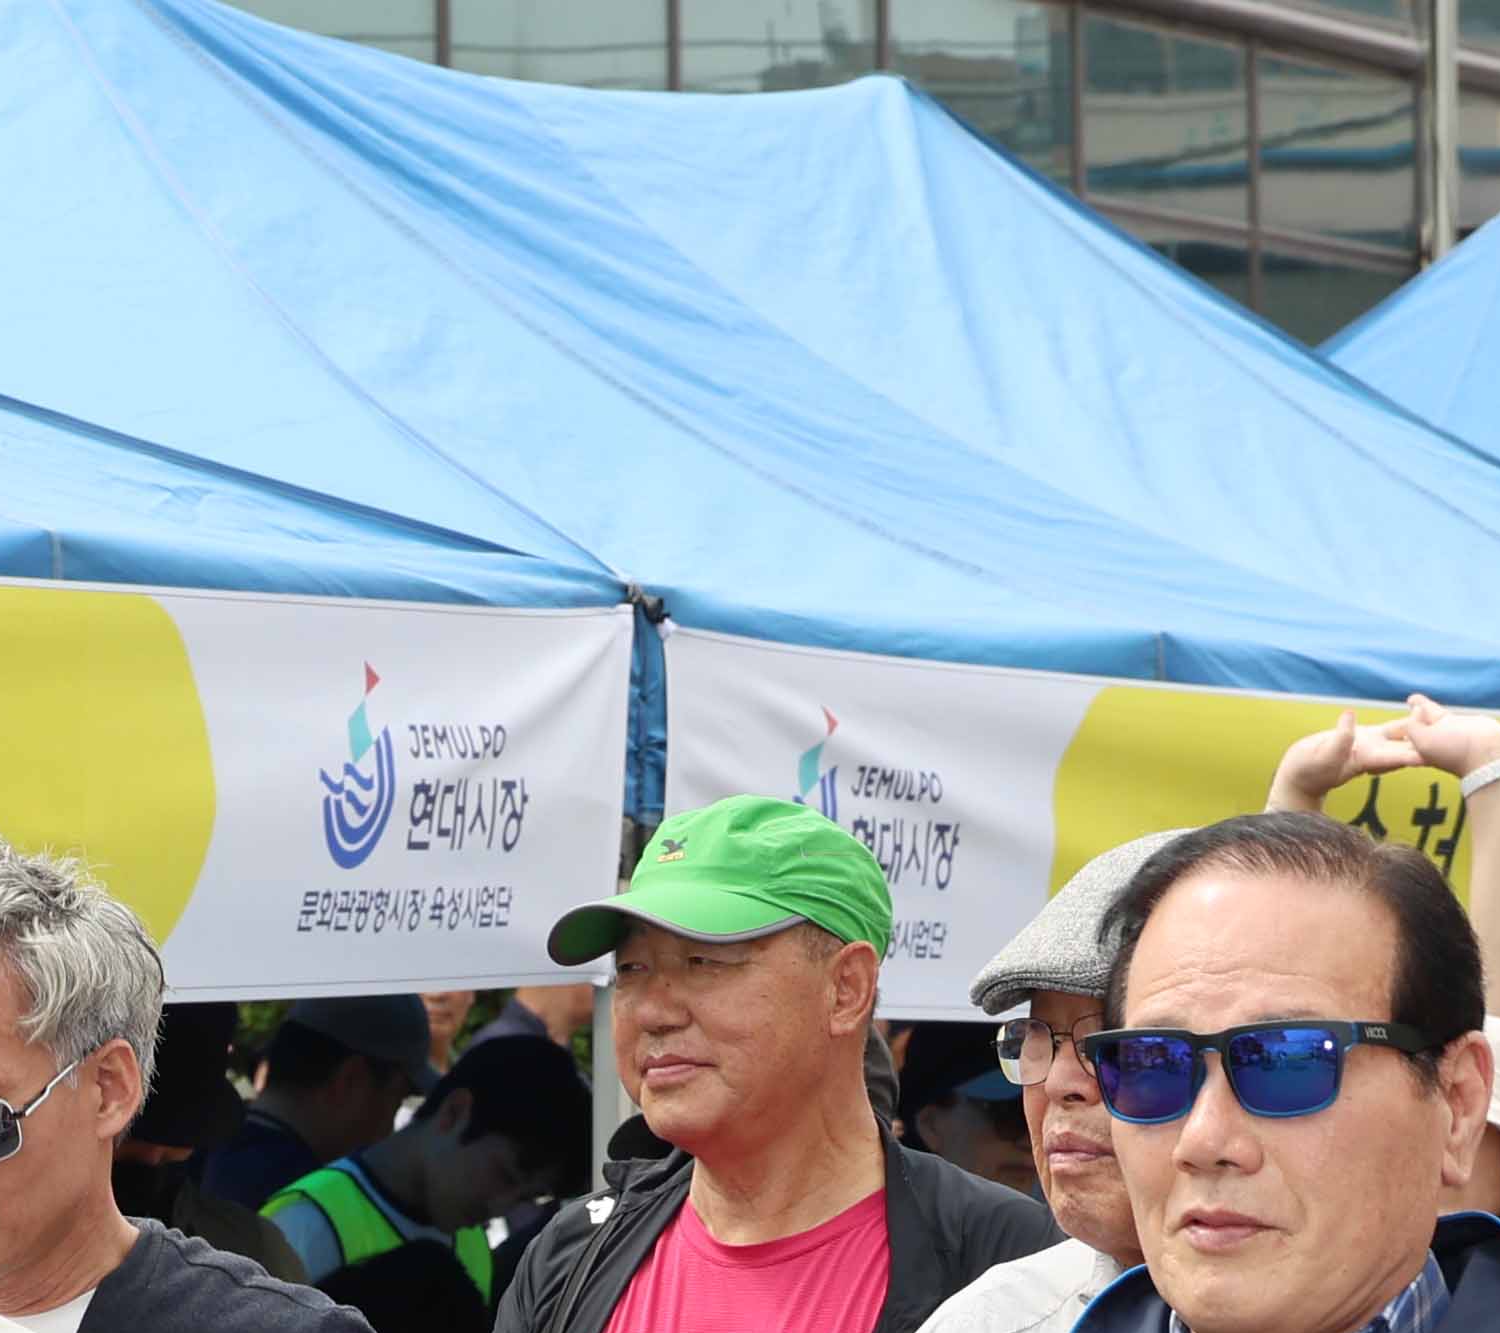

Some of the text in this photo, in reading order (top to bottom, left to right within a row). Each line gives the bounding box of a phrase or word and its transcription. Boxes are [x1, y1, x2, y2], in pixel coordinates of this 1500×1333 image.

[408, 724, 507, 759] JEMULPO
[850, 764, 943, 804] JEMULPO
[406, 777, 529, 853] 현대시장
[297, 885, 513, 933] 문화관광형시장 육성사업단
